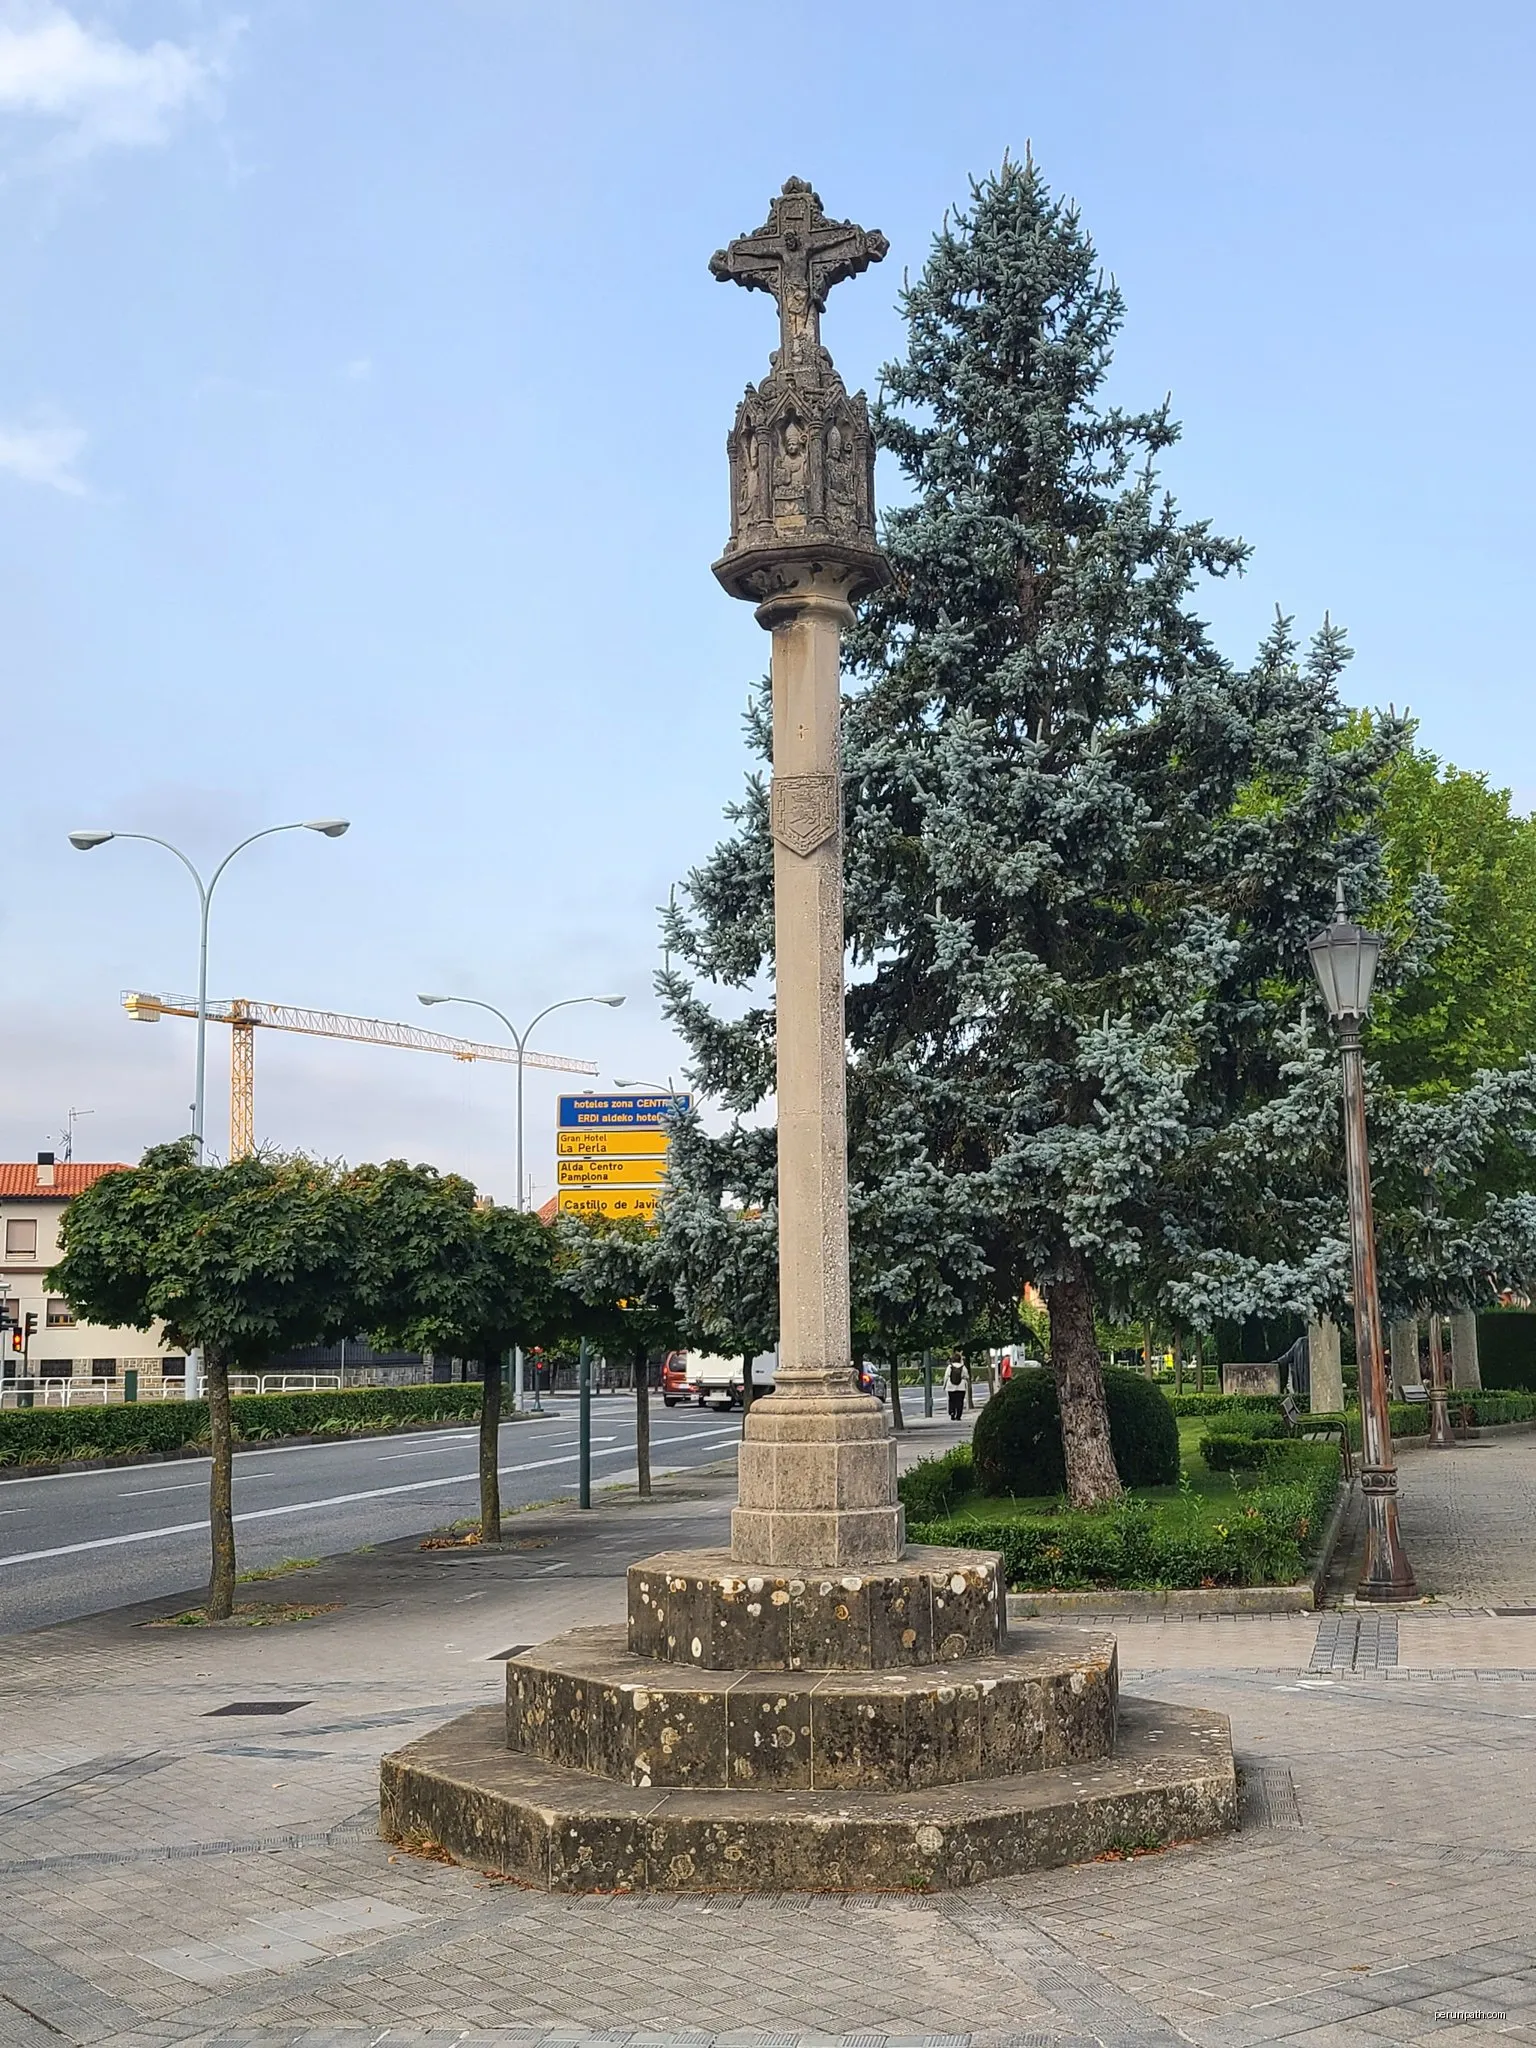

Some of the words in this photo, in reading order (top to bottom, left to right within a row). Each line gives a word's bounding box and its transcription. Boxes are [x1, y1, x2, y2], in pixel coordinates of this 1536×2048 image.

[574, 1100, 609, 1109] hoteles
[636, 1099, 669, 1108] CENTR
[578, 1114, 599, 1123] ERDI
[602, 1113, 634, 1122] aldeko
[636, 1112, 669, 1122] hotel
[560, 1134, 581, 1142] Gran
[583, 1133, 607, 1142] Hotel
[560, 1143, 573, 1153] La
[578, 1142, 607, 1153] Perla
[561, 1162, 584, 1171] Alda
[589, 1162, 624, 1171] Centro
[560, 1173, 609, 1182] Pamplona
[564, 1200, 608, 1210] Castillo
[614, 1200, 628, 1209] de
[633, 1199, 661, 1209] Javie
